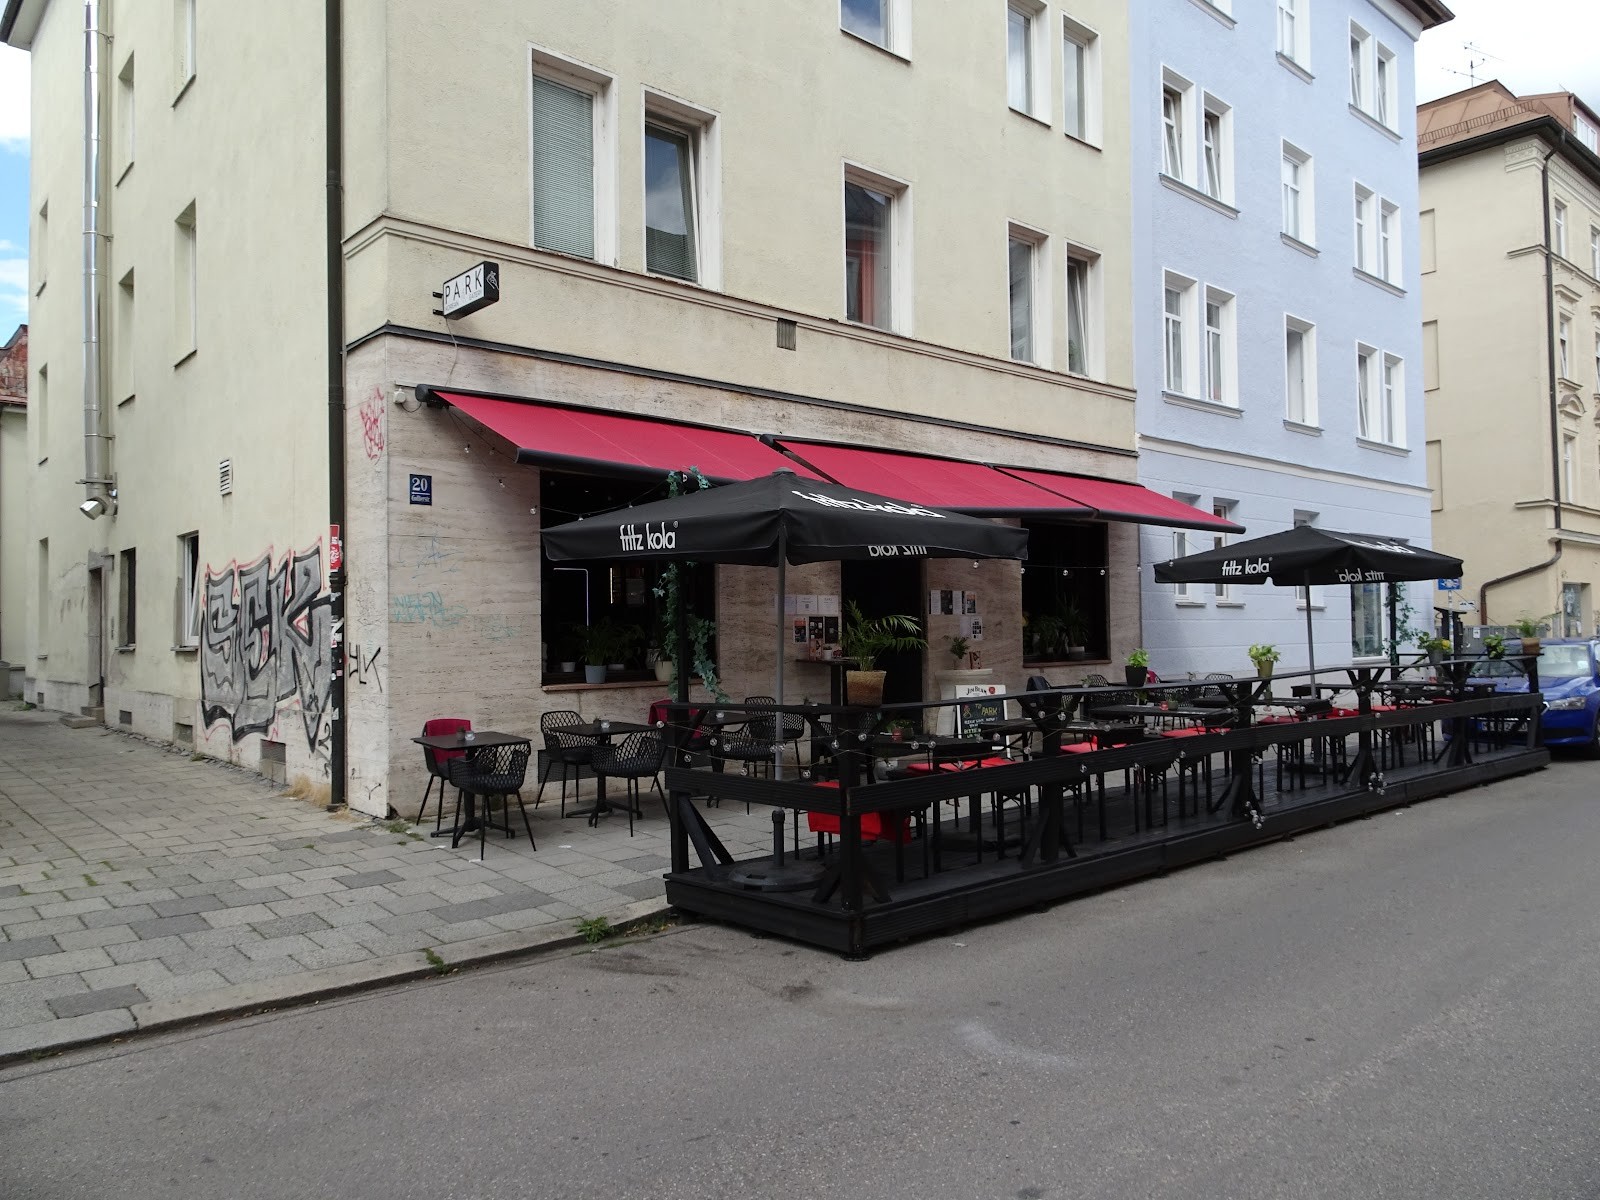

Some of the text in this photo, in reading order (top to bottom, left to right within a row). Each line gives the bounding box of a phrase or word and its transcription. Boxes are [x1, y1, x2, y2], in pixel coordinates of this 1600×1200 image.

[445, 268, 482, 304] PARK
[412, 477, 428, 492] 20
[619, 521, 676, 551] fritz kola
[1222, 557, 1270, 576] fritz kola
